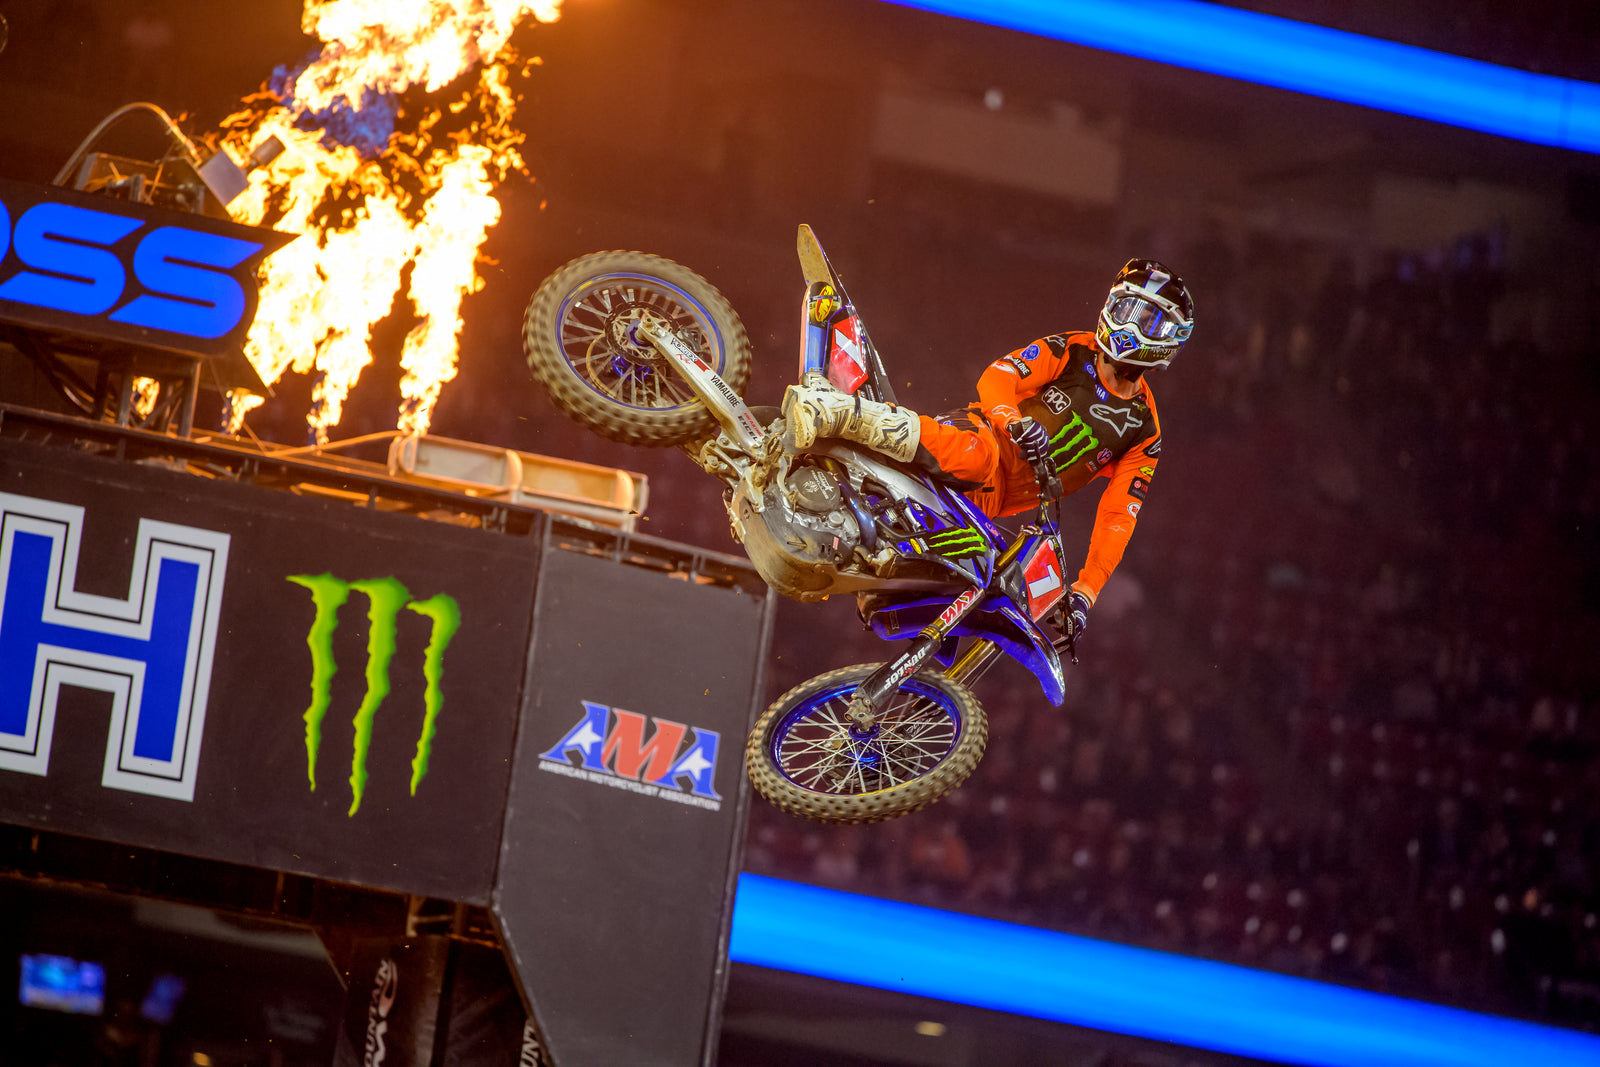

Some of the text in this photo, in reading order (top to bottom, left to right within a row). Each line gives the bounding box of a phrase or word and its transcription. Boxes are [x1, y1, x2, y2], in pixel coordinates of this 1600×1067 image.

[0, 201, 265, 338] SS
[710, 375, 740, 408] YAMALUBE
[737, 415, 759, 441] EXCEL
[1028, 564, 1061, 600] 1
[940, 585, 980, 626] KYB
[883, 646, 926, 690] DUNLOP
[538, 700, 722, 800] AMA
[538, 760, 721, 812] AMERICAN MOTORCYCLIST ASSOCIATION
